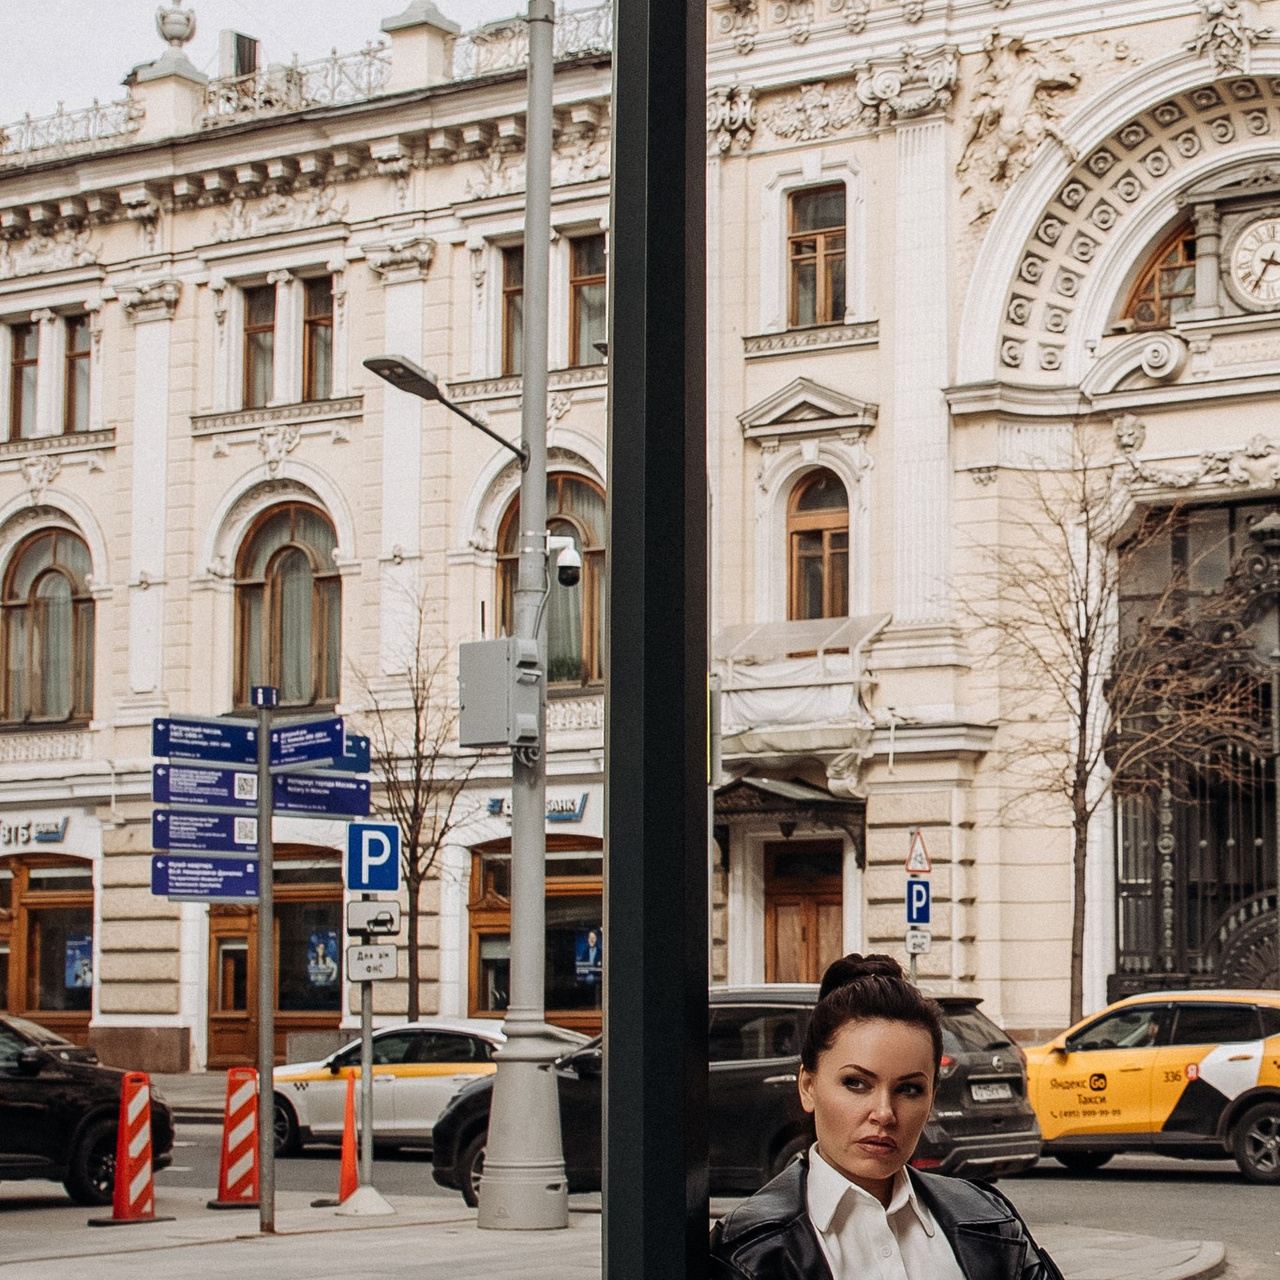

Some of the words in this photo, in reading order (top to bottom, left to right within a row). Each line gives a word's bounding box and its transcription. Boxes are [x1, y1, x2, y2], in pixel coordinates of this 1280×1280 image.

[362, 830, 391, 884] P
[912, 884, 927, 919] P
[1050, 1078, 1087, 1090] Яндекс
[1091, 1076, 1106, 1089] Go
[1163, 1071, 1182, 1083] 336
[1077, 1093, 1107, 1105] Такси
